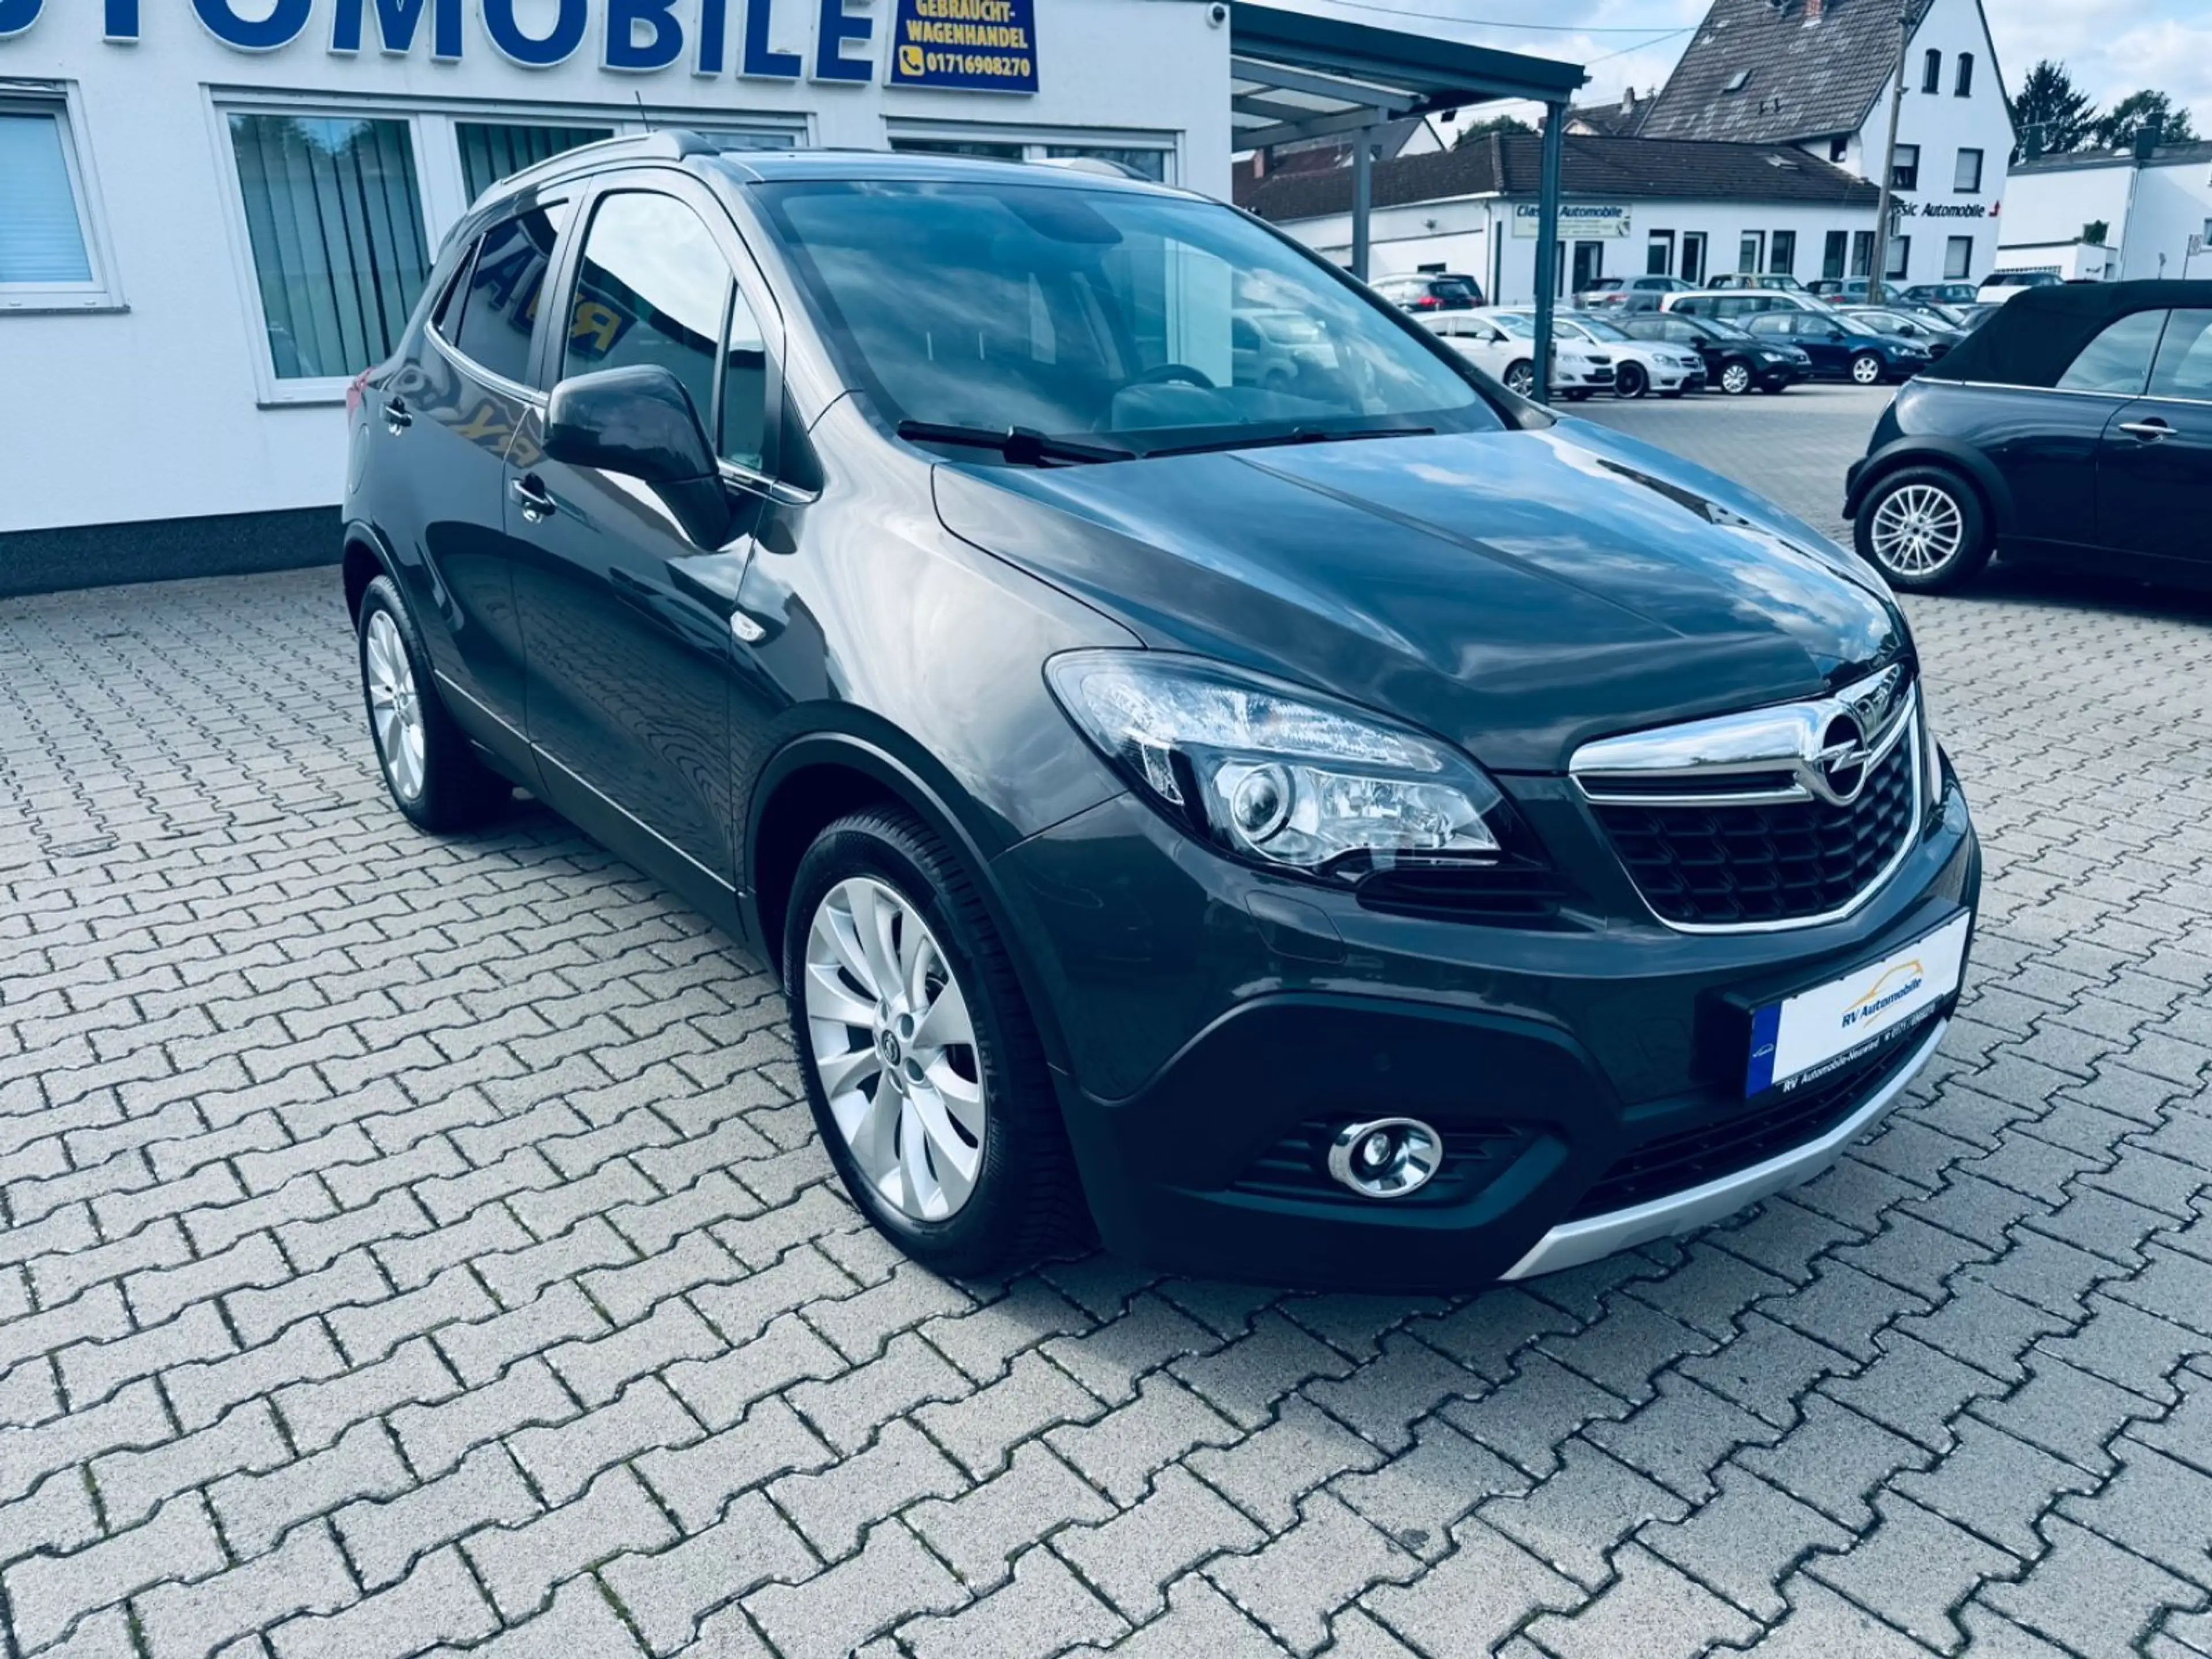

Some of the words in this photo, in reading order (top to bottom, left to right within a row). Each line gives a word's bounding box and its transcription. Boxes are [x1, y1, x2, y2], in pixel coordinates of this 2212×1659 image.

[915, 0, 1016, 22] GEBRAUCHT-
[906, 19, 1029, 49] WAGENHANDEL
[926, 52, 1031, 77] 01716908270
[1559, 205, 1623, 218] Automobile
[1921, 202, 1985, 218] Automobile
[1842, 1010, 1861, 1028] RV
[1861, 977, 1922, 1019] Automobile
[1782, 1075, 1799, 1093] RV
